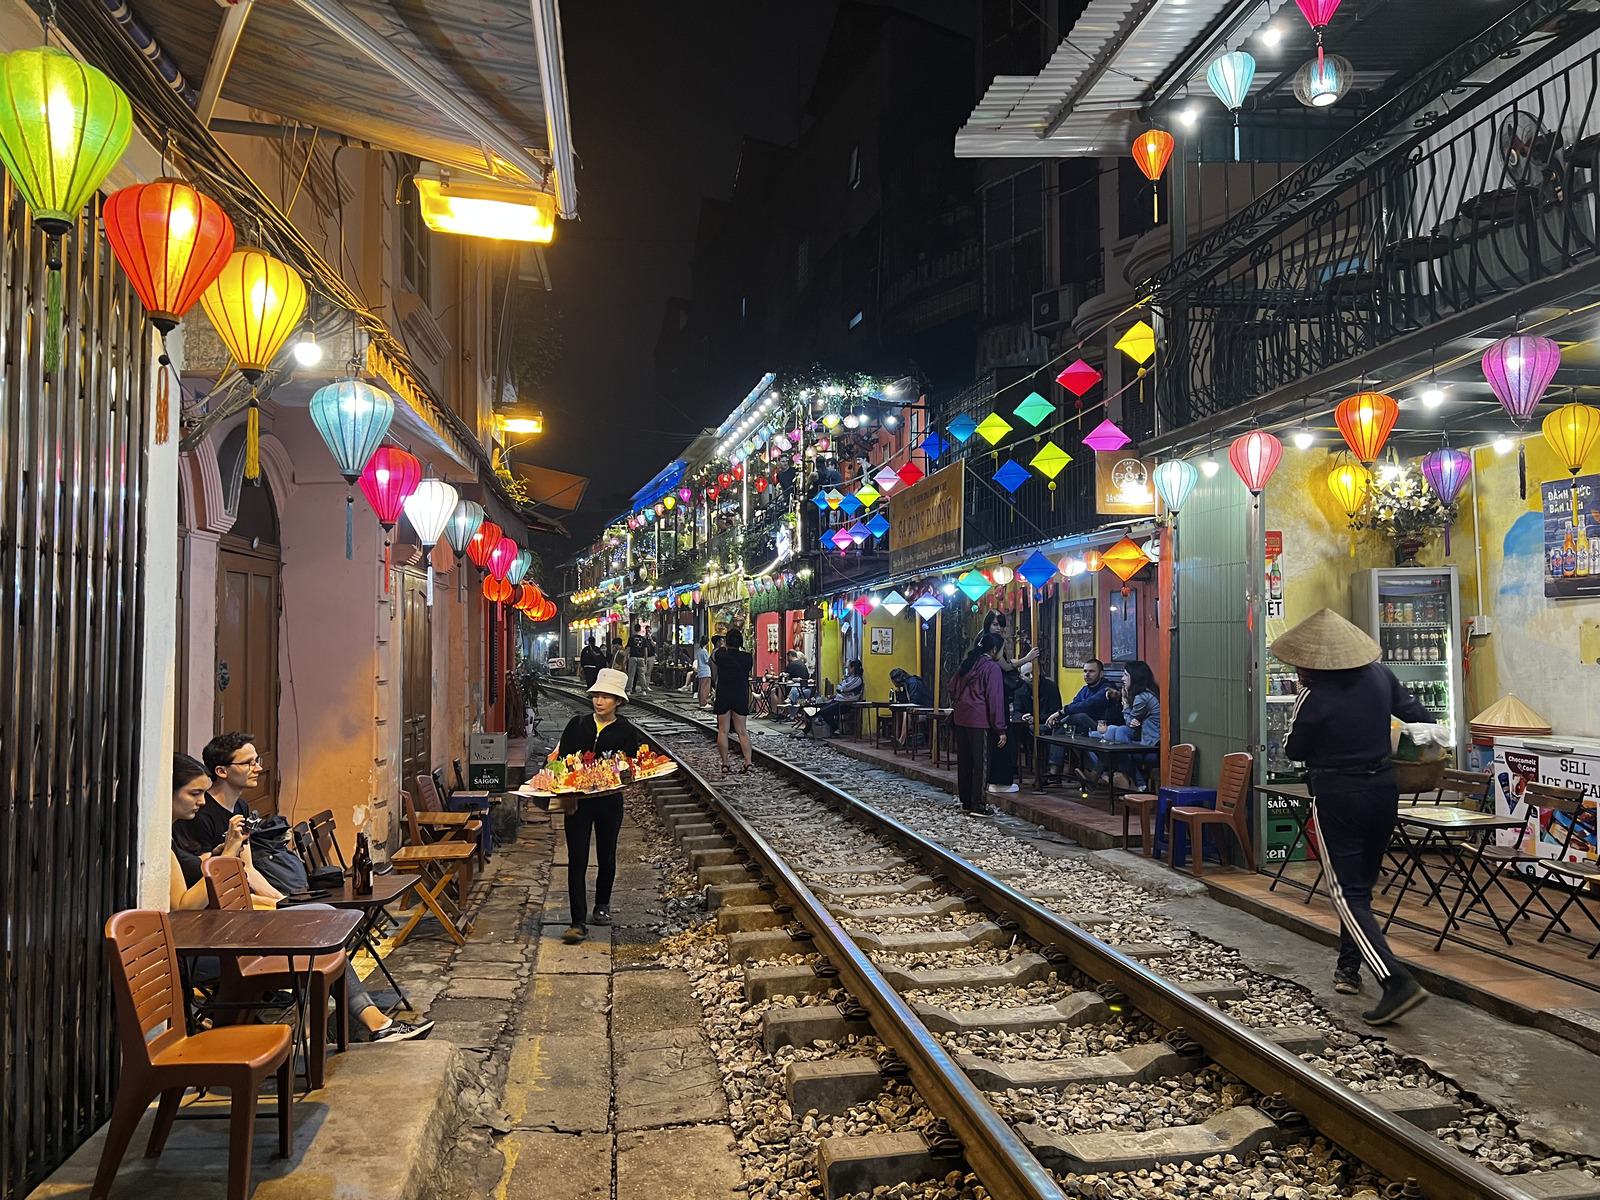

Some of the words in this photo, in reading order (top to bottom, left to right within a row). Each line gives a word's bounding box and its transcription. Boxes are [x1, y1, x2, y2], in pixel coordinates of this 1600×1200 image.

[1548, 488, 1569, 501] ĐÁNH
[1549, 501, 1564, 514] BẢN
[1508, 755, 1537, 765] Chocomelt
[1522, 765, 1537, 773] Cone
[1560, 758, 1590, 776] SELL
[1542, 775, 1561, 787] ICE
[1565, 779, 1600, 798] CREA
